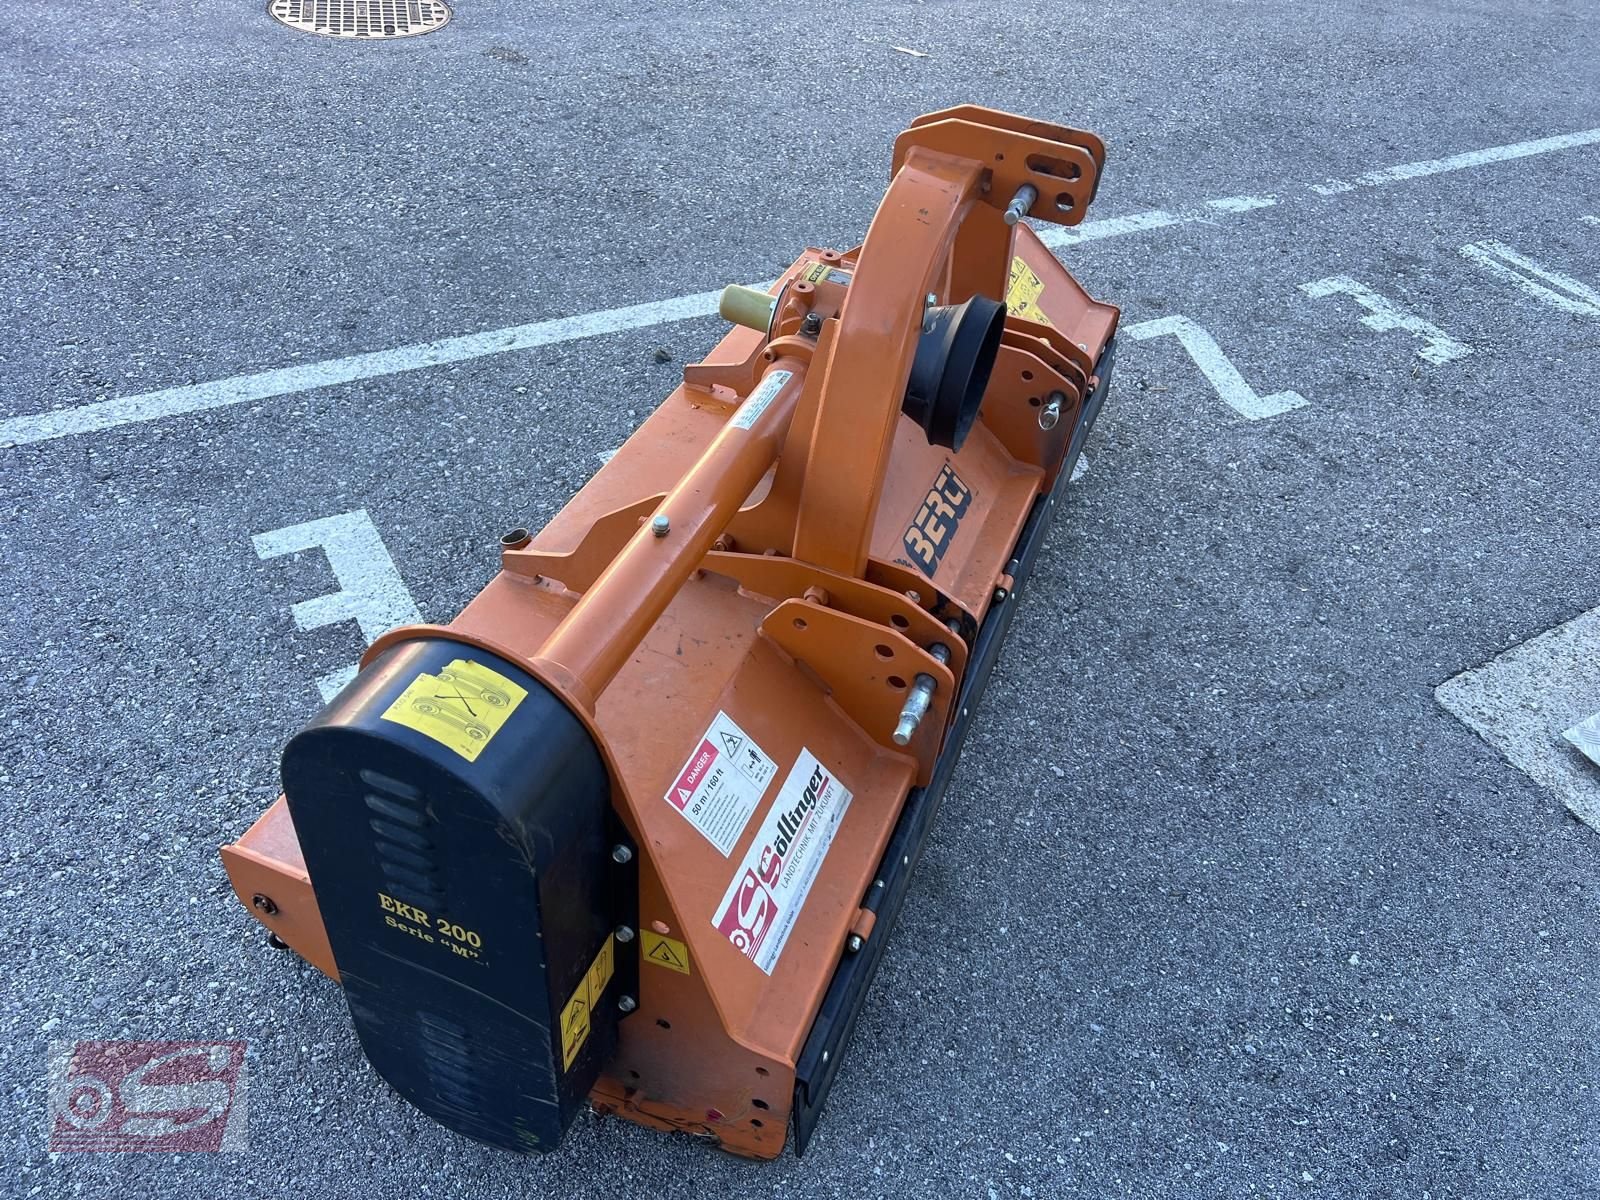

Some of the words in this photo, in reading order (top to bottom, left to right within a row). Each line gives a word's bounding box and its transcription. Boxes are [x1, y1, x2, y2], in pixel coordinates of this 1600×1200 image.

[687, 751, 710, 784] DANGER
[691, 802, 702, 816] 50
[699, 794, 707, 805] m
[706, 773, 719, 791] 160
[714, 766, 723, 777] ft
[757, 764, 827, 889] Söllinger
[780, 833, 810, 889] LANDTECHNIK
[807, 817, 818, 834] MIT
[815, 786, 834, 818] ZUKUNFT
[377, 892, 431, 928] EKR
[436, 918, 482, 949] 200
[384, 915, 434, 944] Serie
